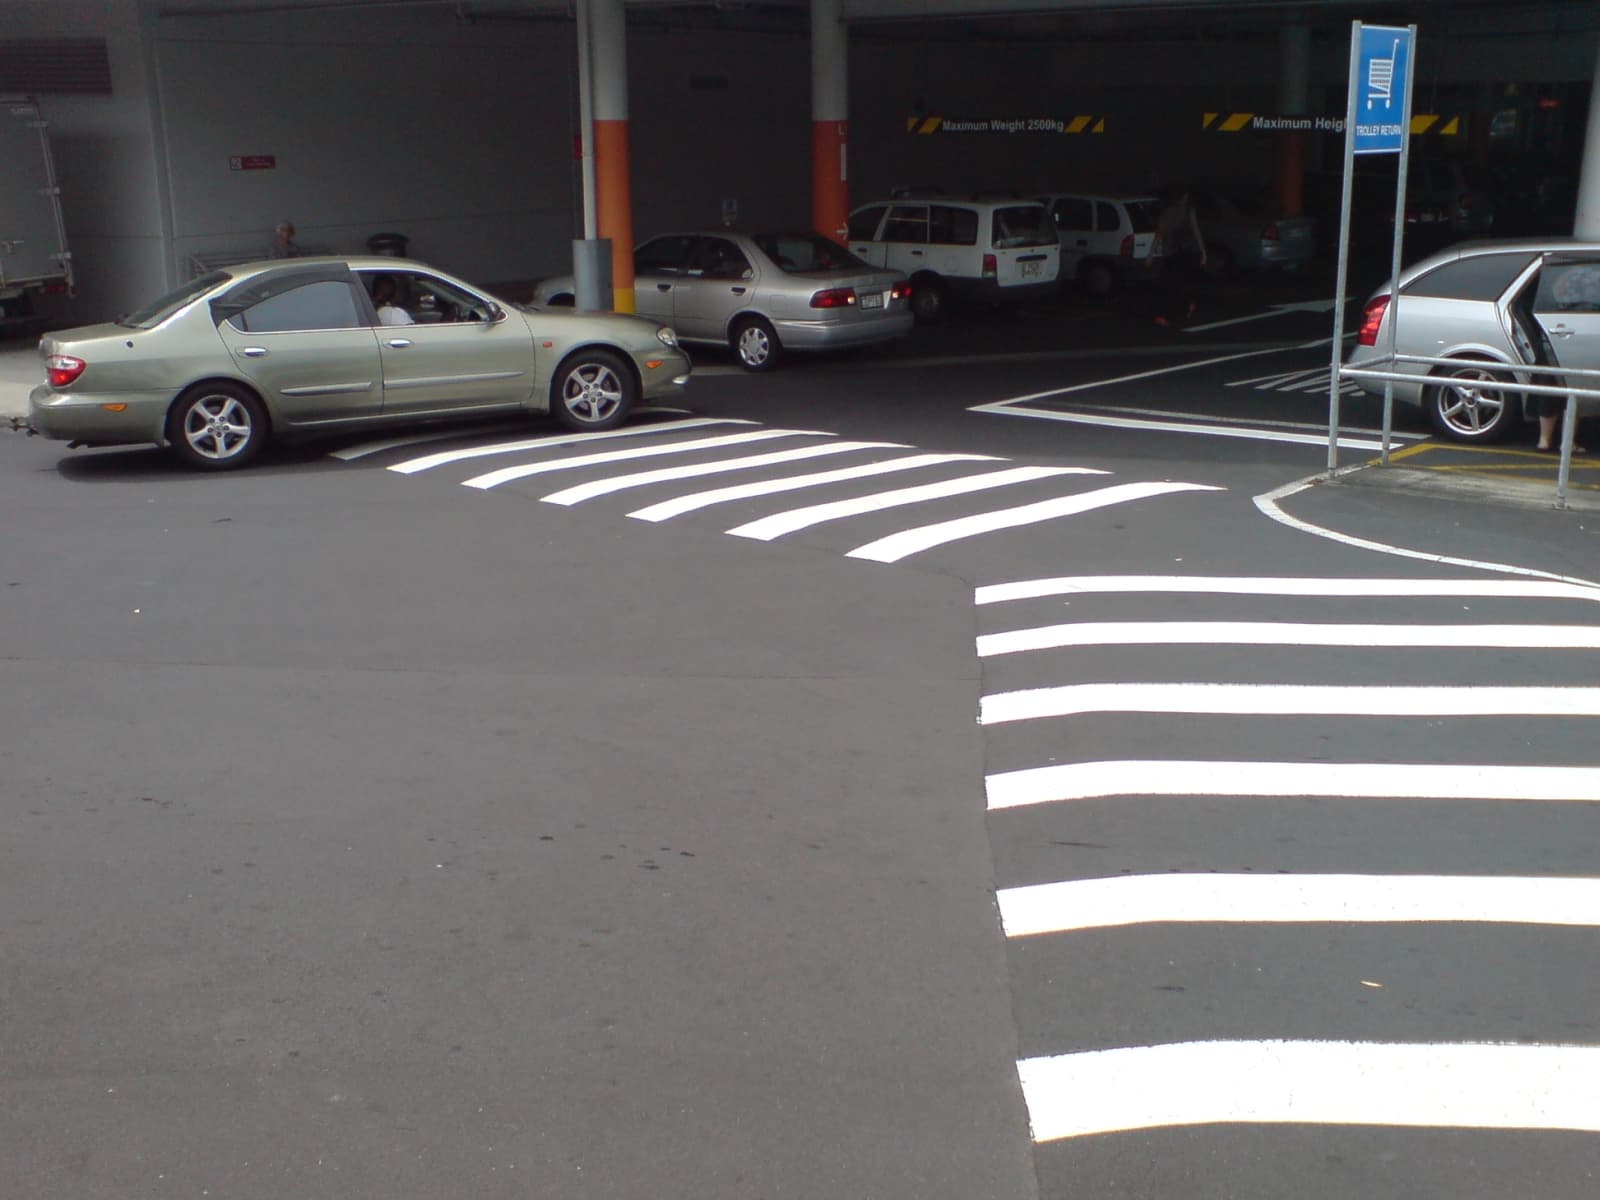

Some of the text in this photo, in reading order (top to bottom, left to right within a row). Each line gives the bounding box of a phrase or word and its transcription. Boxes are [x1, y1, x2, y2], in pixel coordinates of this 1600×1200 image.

[942, 119, 1064, 133] Maximum Weight 2500kg
[1252, 116, 1312, 129] Maximum
[1356, 124, 1402, 137] TROLLEY RETURN
